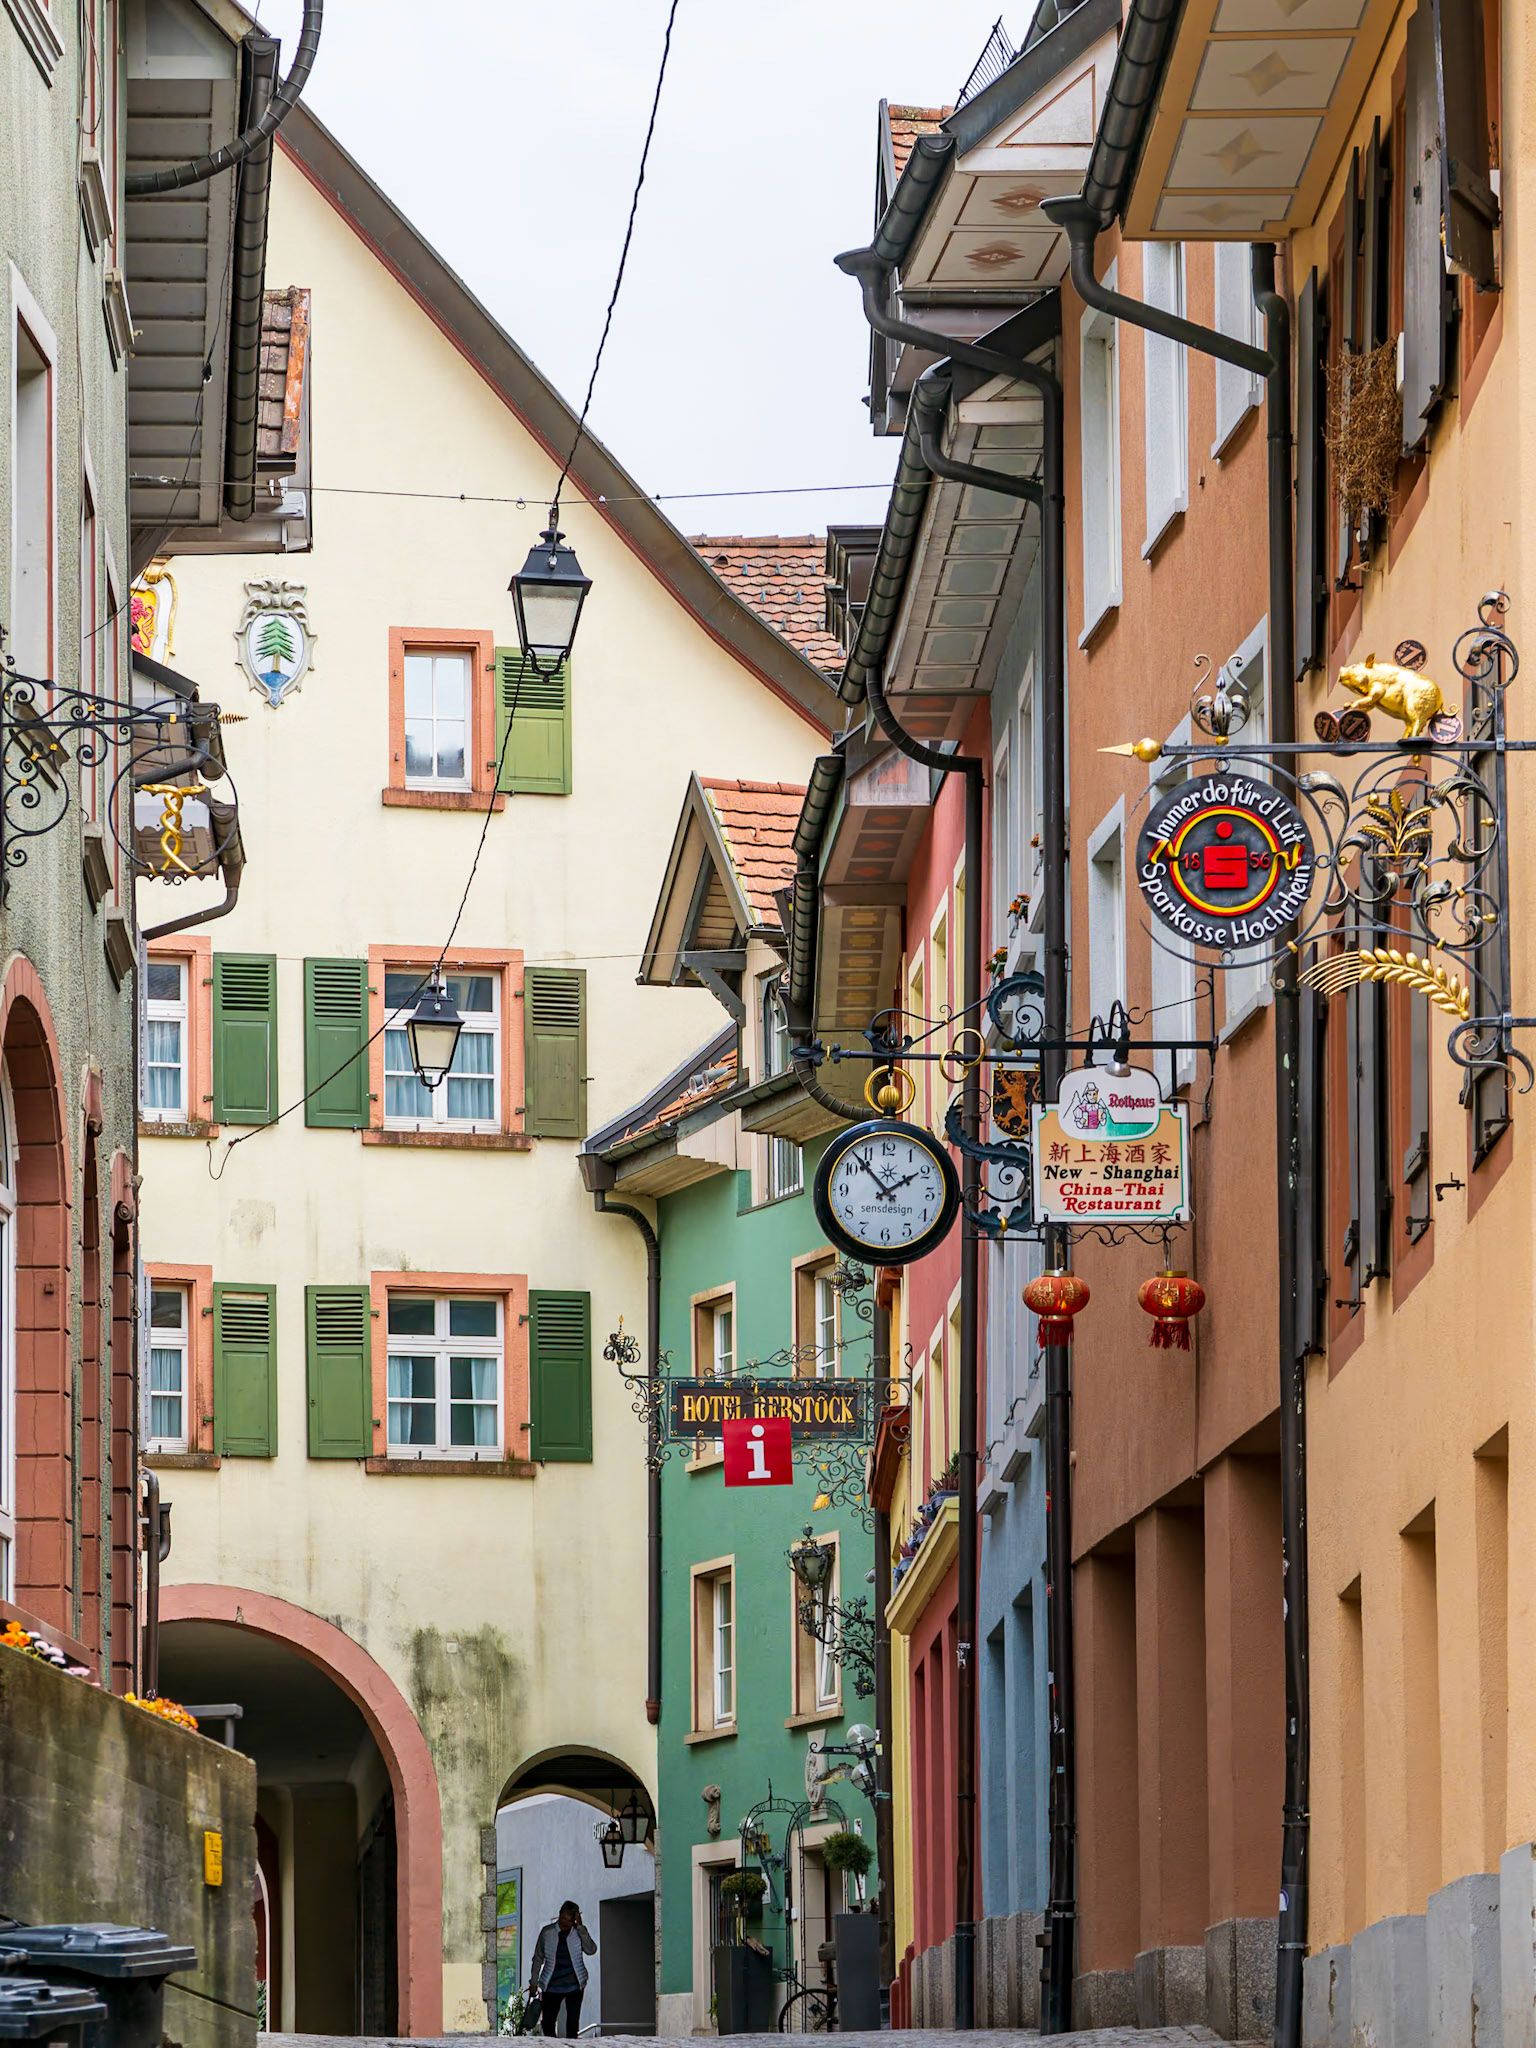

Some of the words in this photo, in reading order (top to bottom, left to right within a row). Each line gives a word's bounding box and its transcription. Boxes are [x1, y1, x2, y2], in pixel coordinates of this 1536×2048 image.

[1147, 791, 1201, 842] Immer
[1202, 779, 1228, 803] do
[1229, 779, 1262, 807] für
[1180, 852, 1201, 870] 18
[1249, 853, 1272, 869] 56
[1138, 862, 1228, 945] Sparkasse
[1230, 865, 1311, 945] Hochrhein
[1108, 1093, 1156, 1111] Rothaus
[863, 1147, 873, 1161] 11
[881, 1142, 896, 1156] 12
[906, 1148, 913, 1163] 1
[1048, 1141, 1172, 1165] 新上海酒家
[845, 1162, 858, 1177] 10
[920, 1165, 930, 1180] 2
[1044, 1165, 1083, 1180] New
[1103, 1165, 1180, 1182] Shanghai
[839, 1183, 849, 1197] 9
[925, 1187, 935, 1201] 3
[844, 1205, 854, 1219] 8
[860, 1203, 913, 1217] sensdesign
[1062, 1197, 1162, 1215] Restaurant
[917, 1208, 929, 1222] 4
[858, 1221, 869, 1236] 7
[880, 1227, 890, 1242] 6
[902, 1223, 912, 1237] 5
[682, 1395, 747, 1422] HOTEL
